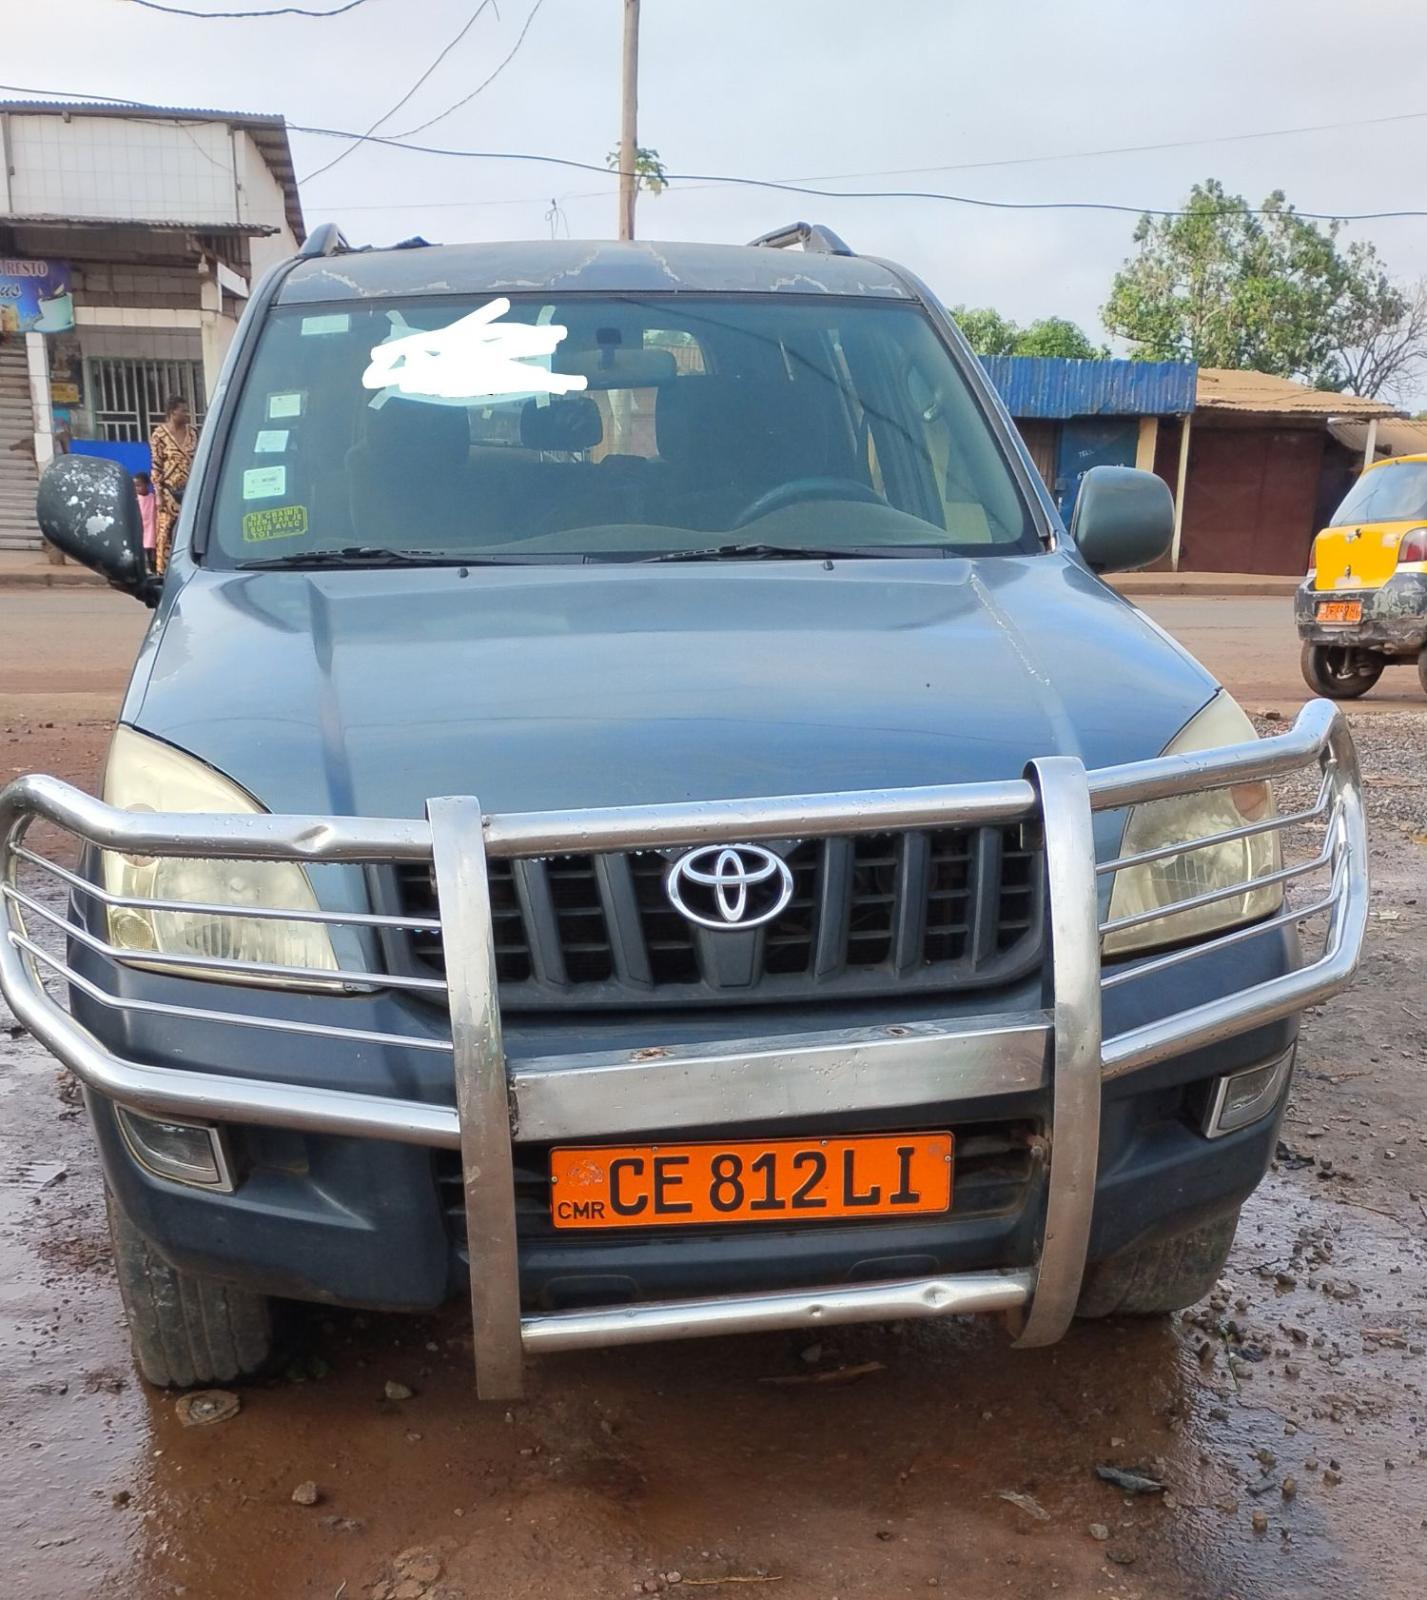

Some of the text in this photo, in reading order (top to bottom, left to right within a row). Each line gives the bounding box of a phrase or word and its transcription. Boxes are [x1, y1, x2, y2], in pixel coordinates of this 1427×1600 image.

[7, 261, 47, 276] RESTO
[609, 1146, 920, 1216] CE 812 LI
[557, 1201, 605, 1220] CMR
